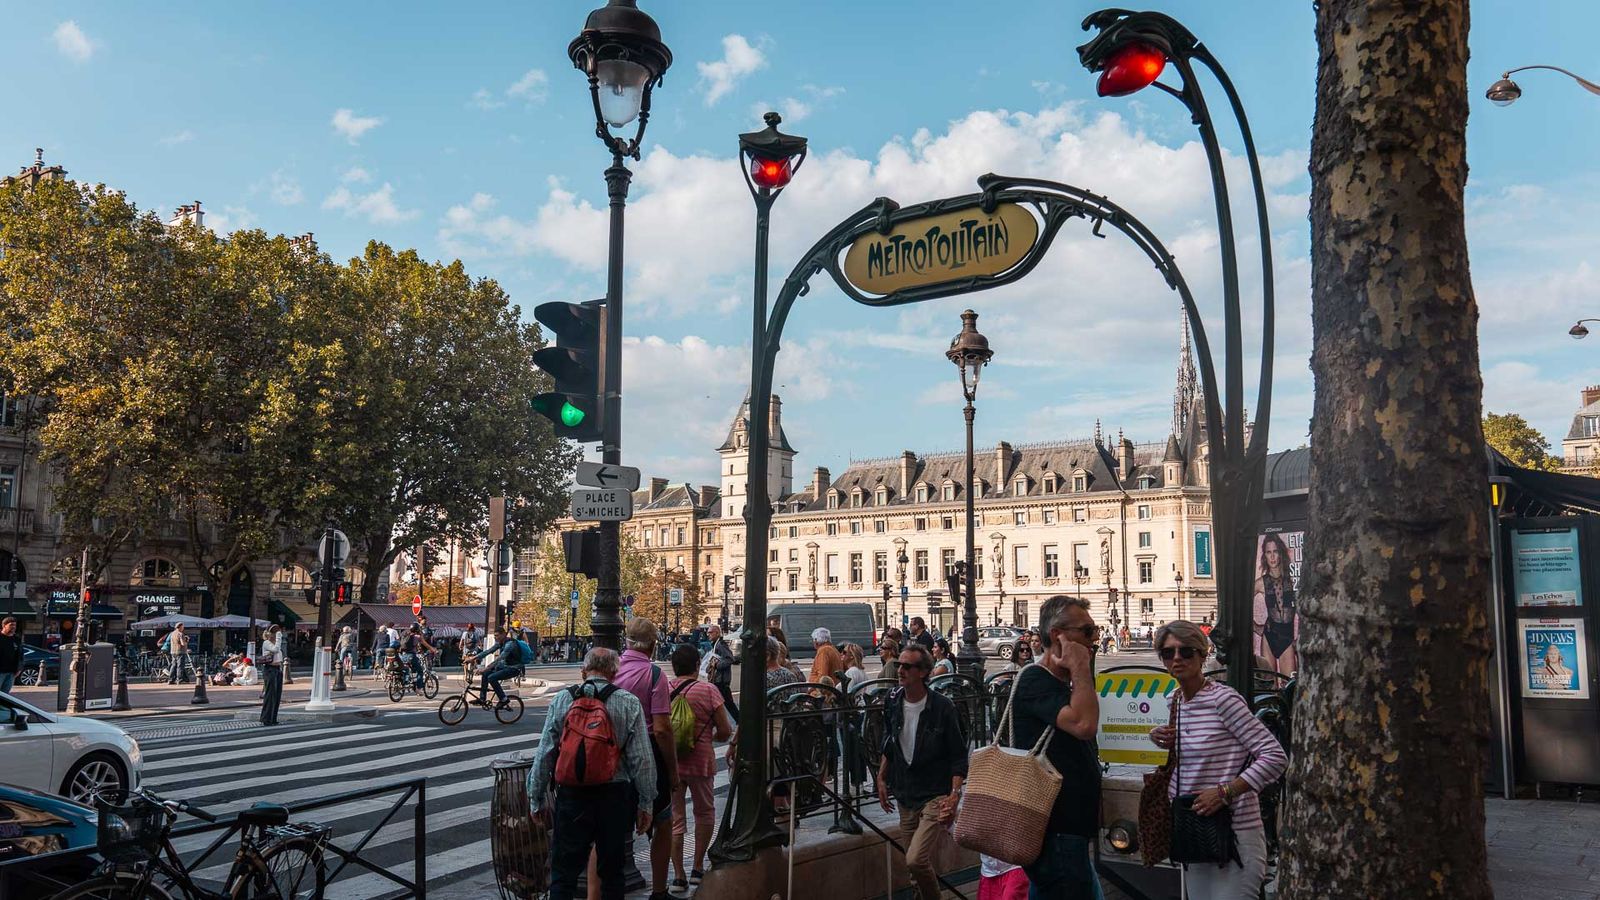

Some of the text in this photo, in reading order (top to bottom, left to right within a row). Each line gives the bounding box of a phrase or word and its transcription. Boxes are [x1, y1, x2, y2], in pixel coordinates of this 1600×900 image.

[868, 215, 1009, 280] METROPOLITAIN
[586, 493, 616, 503] PLACE
[136, 595, 176, 603] CHANGE
[1153, 717, 1168, 725] ligne
